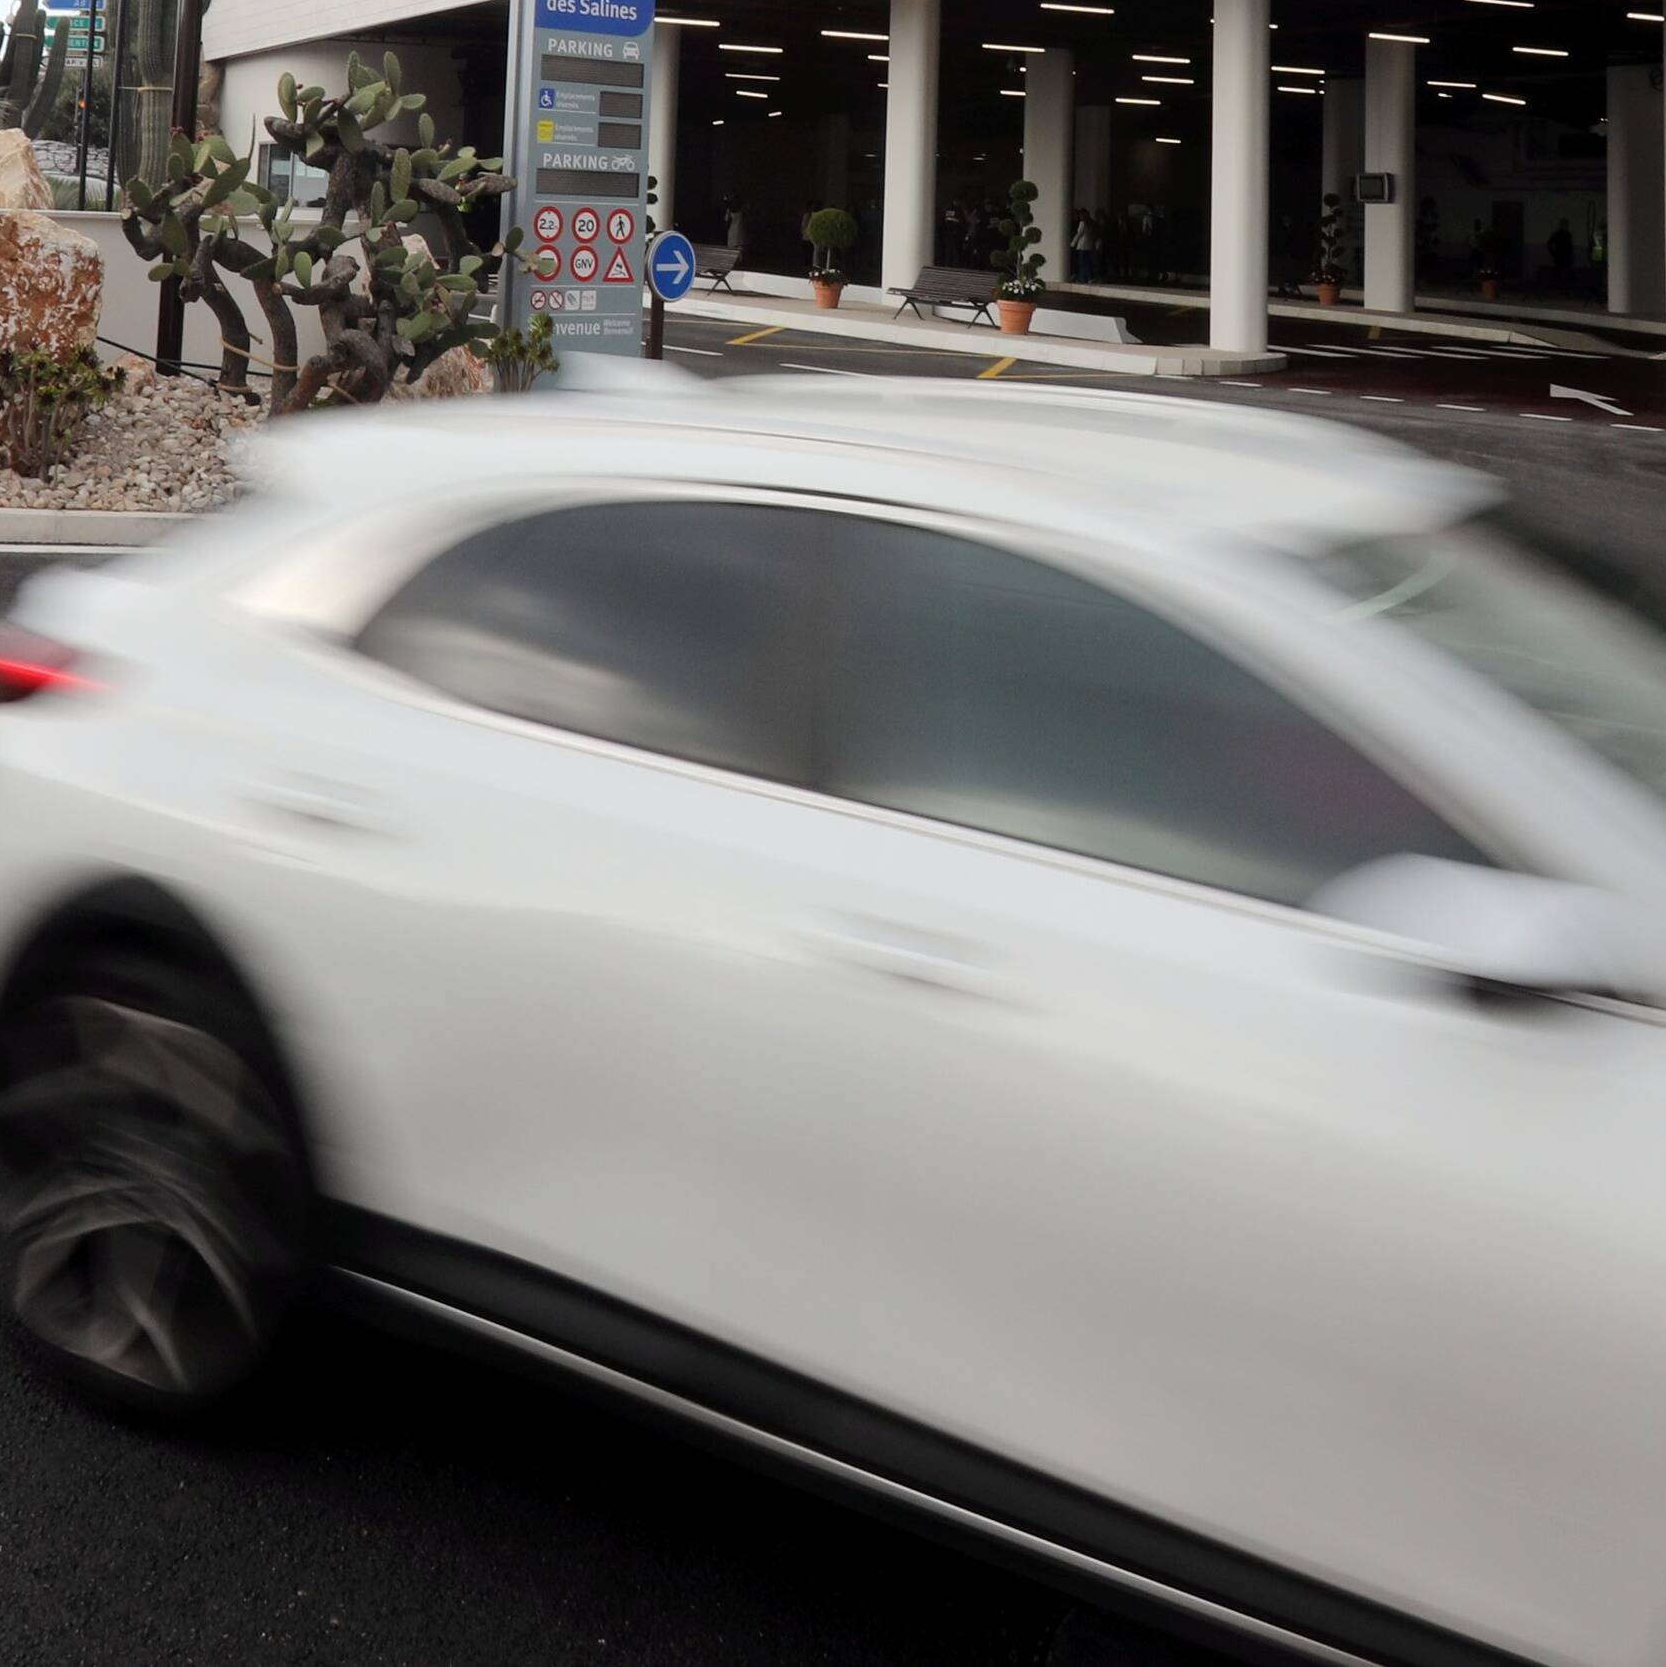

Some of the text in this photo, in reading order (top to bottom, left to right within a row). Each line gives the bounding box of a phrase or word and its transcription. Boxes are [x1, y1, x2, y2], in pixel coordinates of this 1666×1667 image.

[547, 37, 614, 58] PARKING
[542, 152, 609, 170] PARKING
[577, 219, 595, 233] 20
[575, 258, 594, 269] GNV
